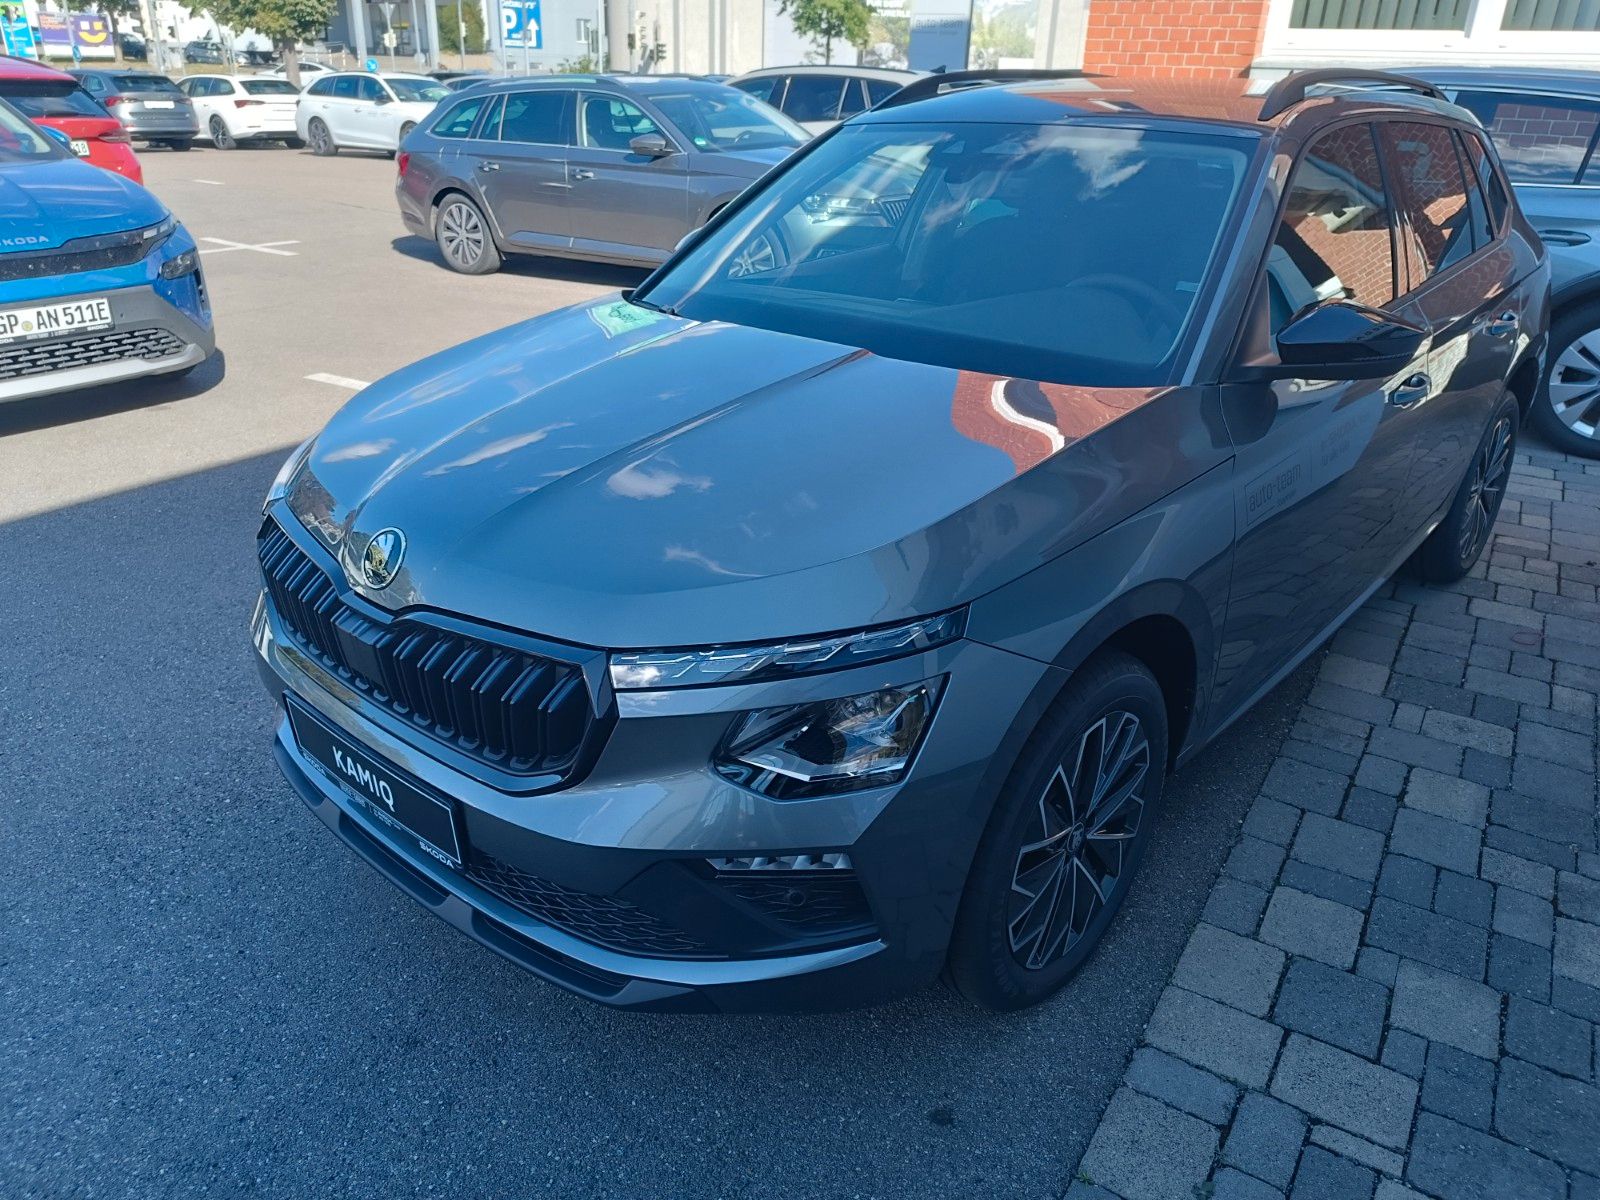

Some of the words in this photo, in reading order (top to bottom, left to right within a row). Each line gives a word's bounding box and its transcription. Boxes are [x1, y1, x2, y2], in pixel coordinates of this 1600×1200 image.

[501, 8, 517, 38] P
[0, 235, 49, 247] KODA
[36, 308, 60, 330] AN
[62, 302, 109, 326] 511E
[332, 745, 396, 813] KAMIQ
